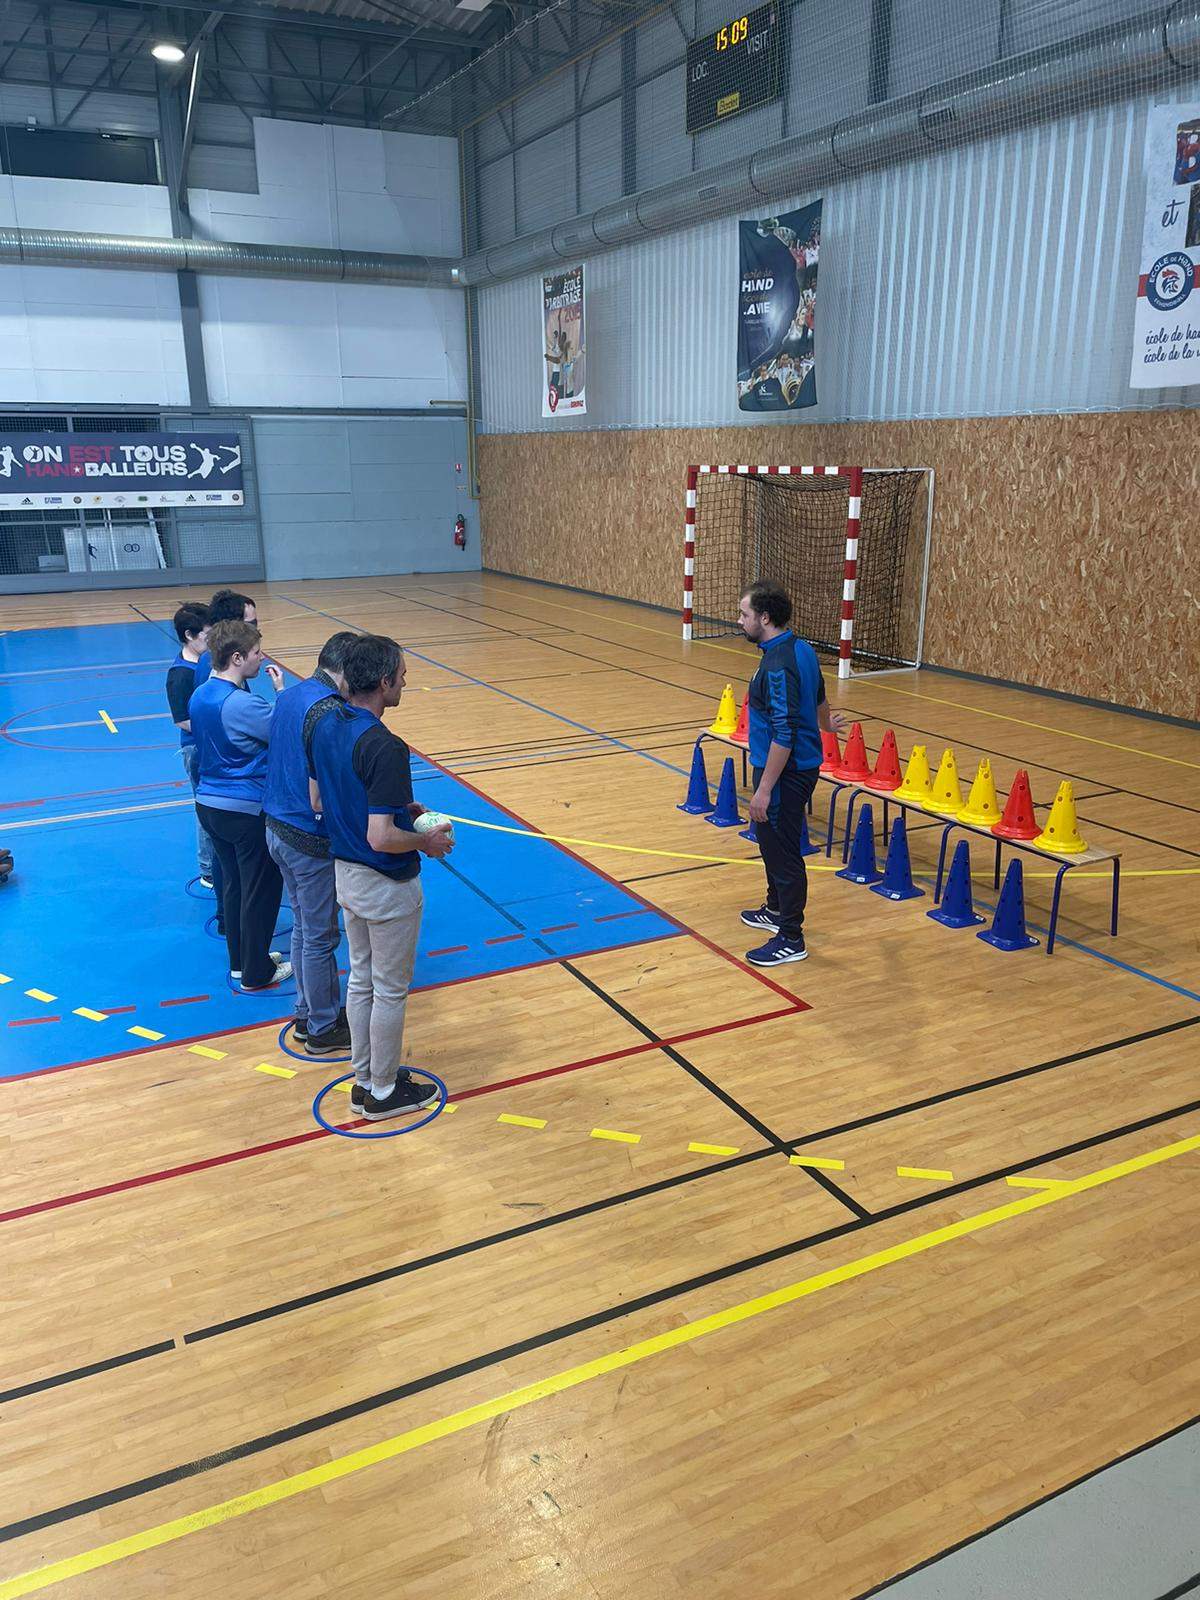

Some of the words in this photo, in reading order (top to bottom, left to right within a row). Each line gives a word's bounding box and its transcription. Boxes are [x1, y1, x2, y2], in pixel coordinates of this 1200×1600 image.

[731, 16, 749, 45] 09
[1161, 199, 1185, 228] et
[1145, 327, 1169, 345] école
[1170, 325, 1184, 342] de
[1144, 345, 1167, 363] école
[1168, 344, 1180, 361] de
[1182, 342, 1195, 359] la
[23, 445, 63, 463] ON
[69, 445, 114, 463] EST
[119, 445, 187, 462] TOUS
